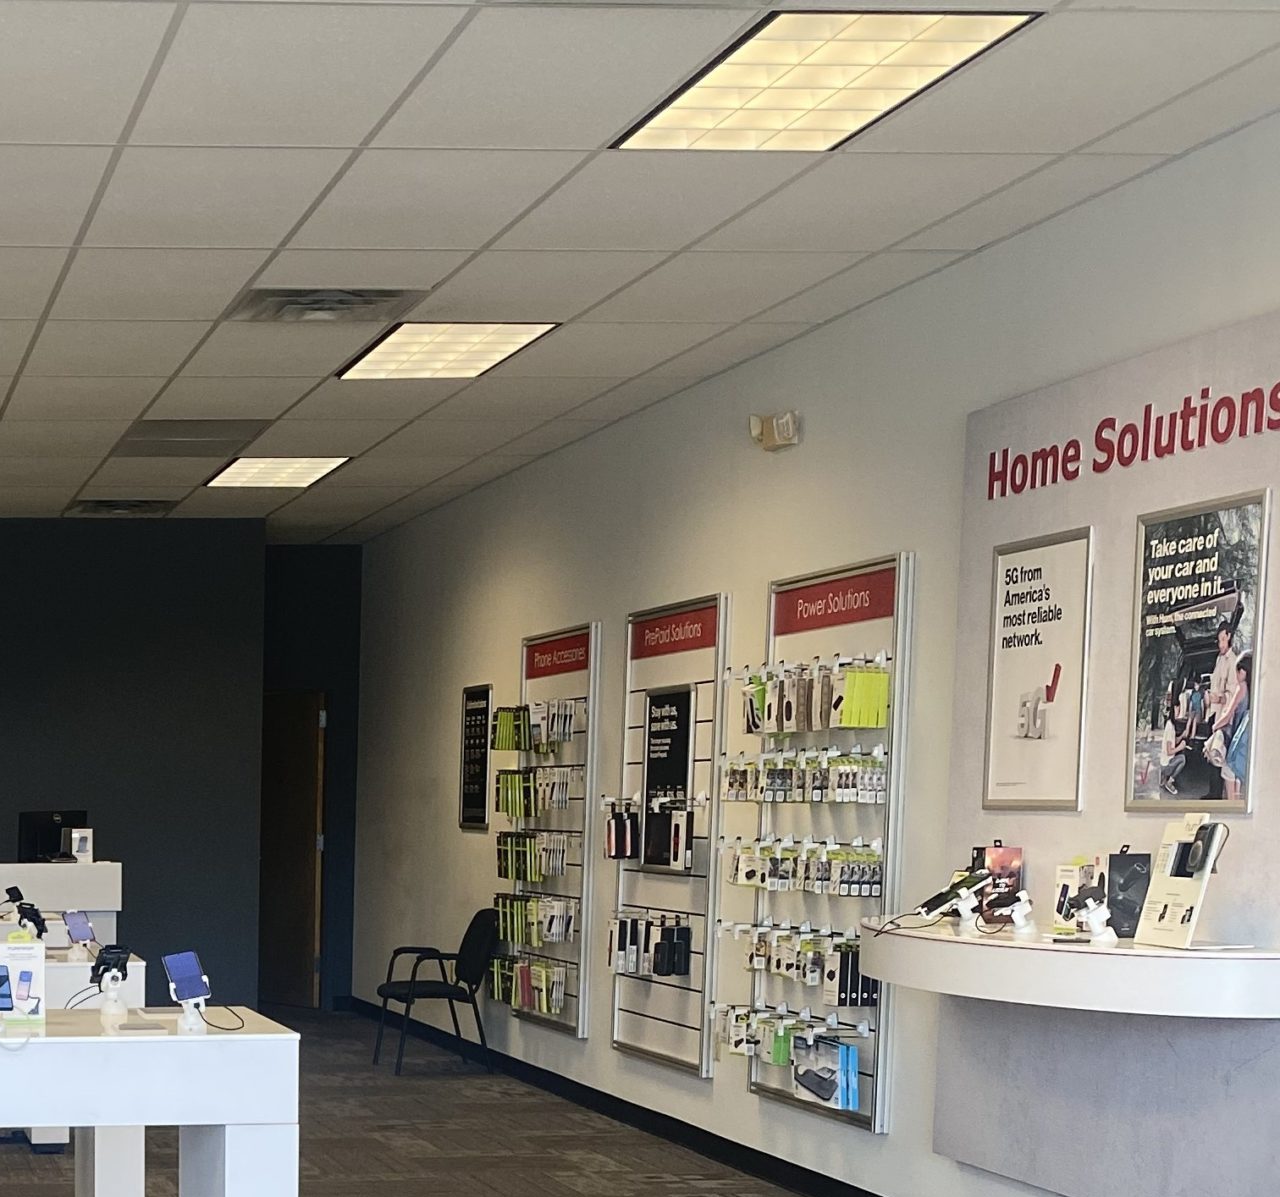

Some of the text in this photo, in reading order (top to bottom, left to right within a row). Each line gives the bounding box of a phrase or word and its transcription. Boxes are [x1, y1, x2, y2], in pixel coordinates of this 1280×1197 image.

[988, 380, 1280, 500] Home Solutions
[1150, 528, 1220, 558] Take care of
[1005, 566, 1042, 585] 5G from
[1148, 552, 1219, 585] your car and
[1004, 584, 1051, 607] America's
[1147, 576, 1225, 605] everyone in it.
[797, 588, 871, 619] Power Solutions
[1184, 606, 1217, 620] connected
[1003, 604, 1062, 628] most reliable
[671, 621, 702, 642] Solutions
[1002, 628, 1043, 649] network.
[534, 646, 586, 668] Phone Accessories
[1018, 687, 1046, 739] 5G
